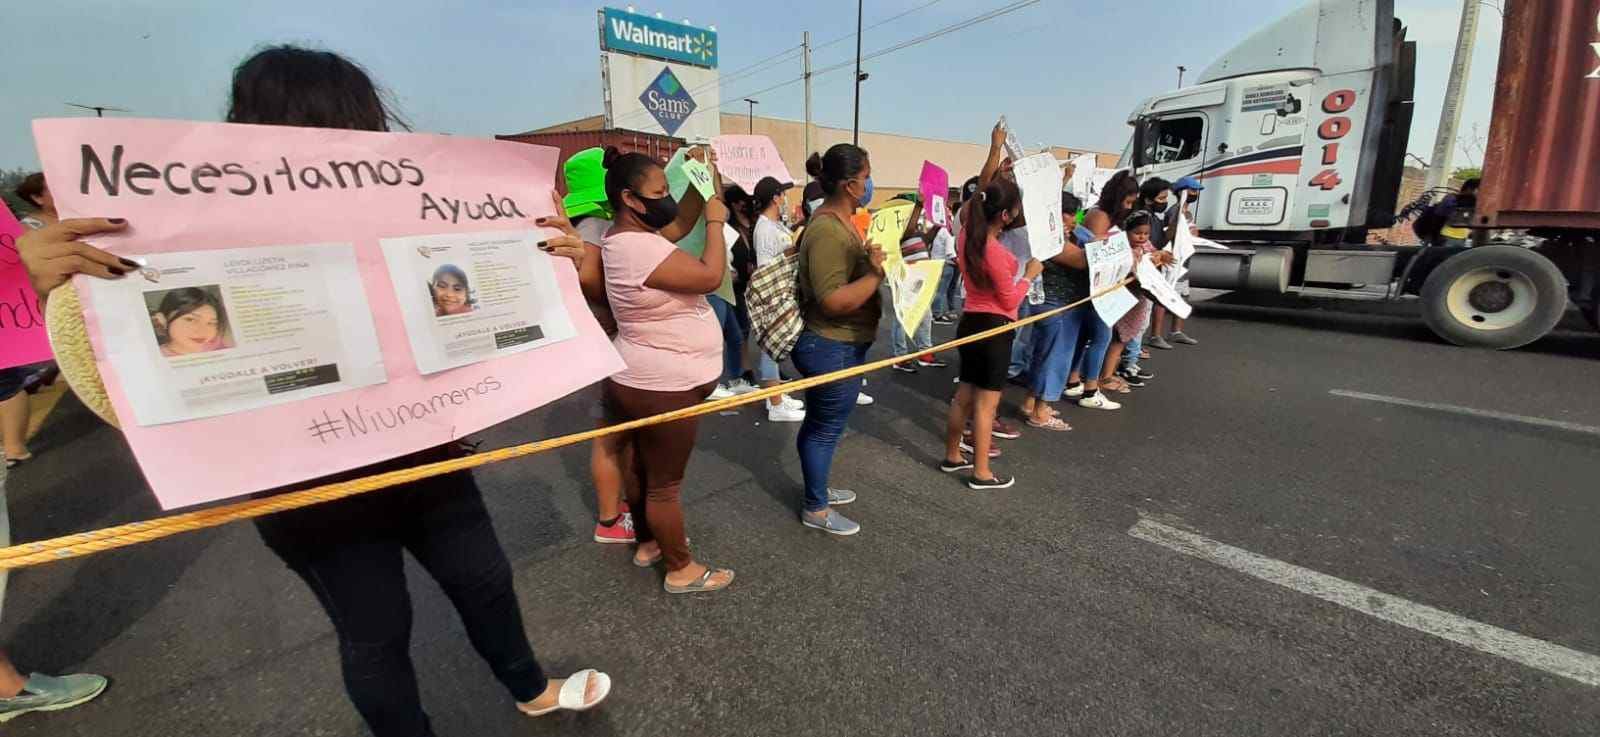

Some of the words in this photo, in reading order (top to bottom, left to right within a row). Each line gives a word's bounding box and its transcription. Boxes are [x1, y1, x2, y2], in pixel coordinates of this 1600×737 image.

[611, 17, 692, 54] Walmart
[80, 144, 424, 196] Necesitamos
[420, 192, 526, 224] Ayuda
